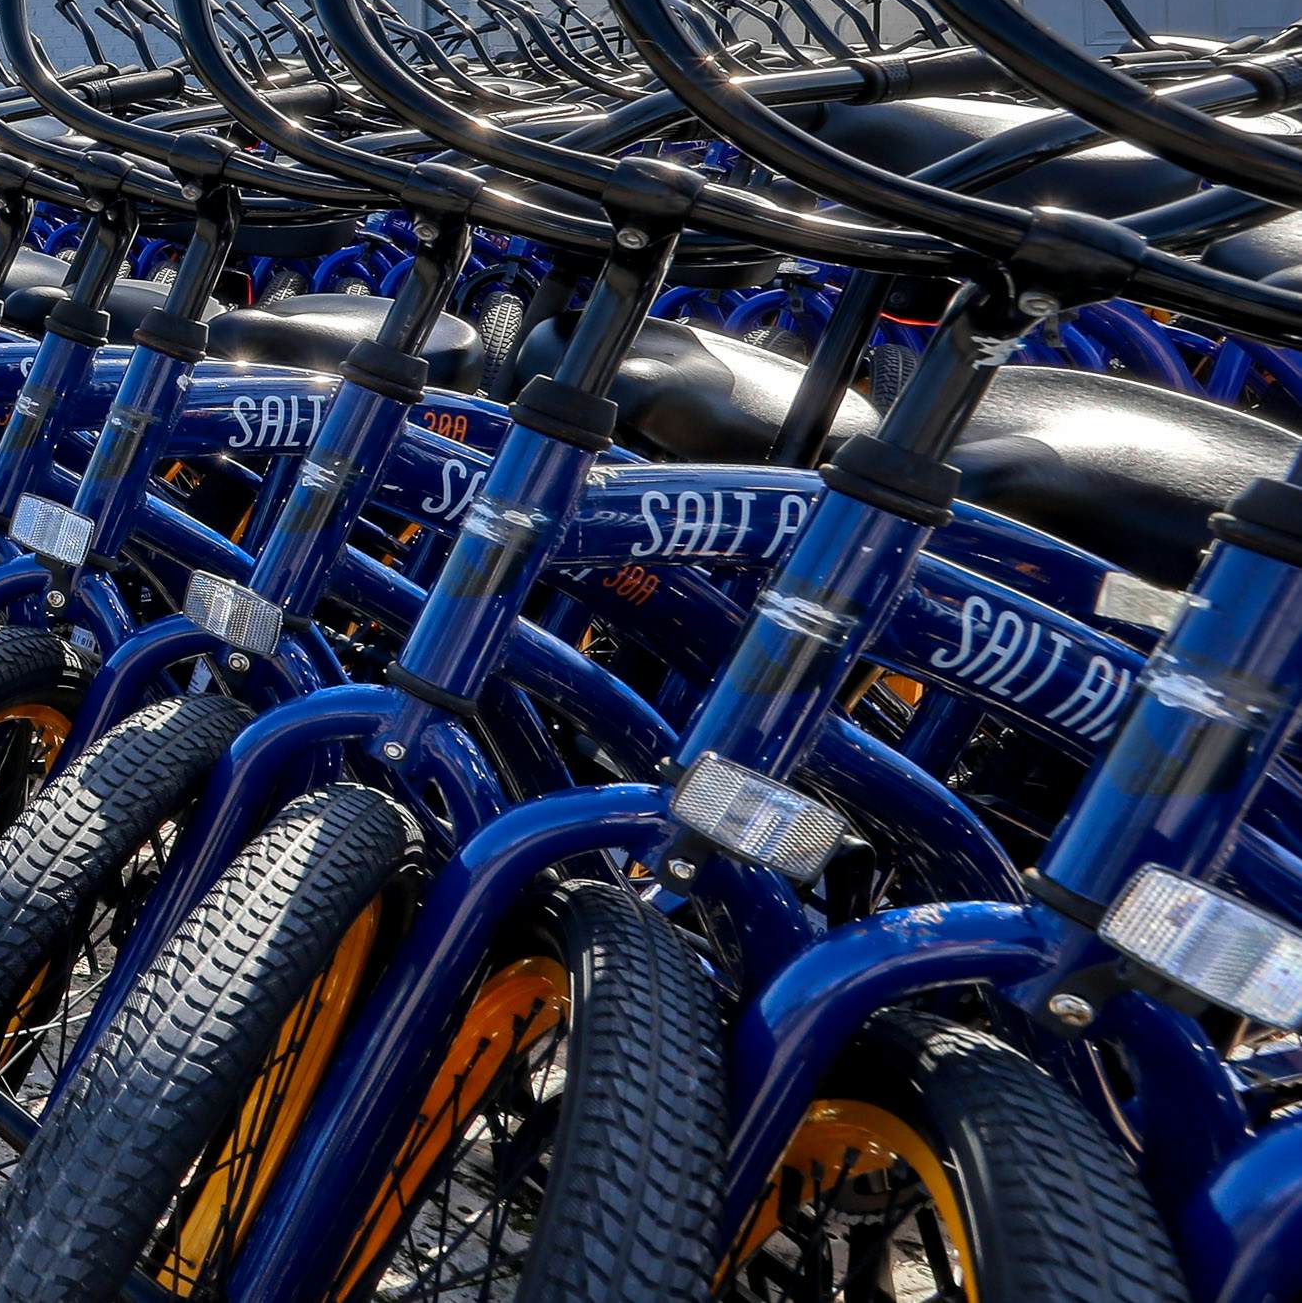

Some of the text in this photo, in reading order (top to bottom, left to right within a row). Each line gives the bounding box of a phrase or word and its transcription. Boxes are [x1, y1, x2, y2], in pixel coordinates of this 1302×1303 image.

[228, 395, 326, 447] SALT
[631, 490, 757, 558] SALT
[930, 595, 1132, 742] SALT AI
